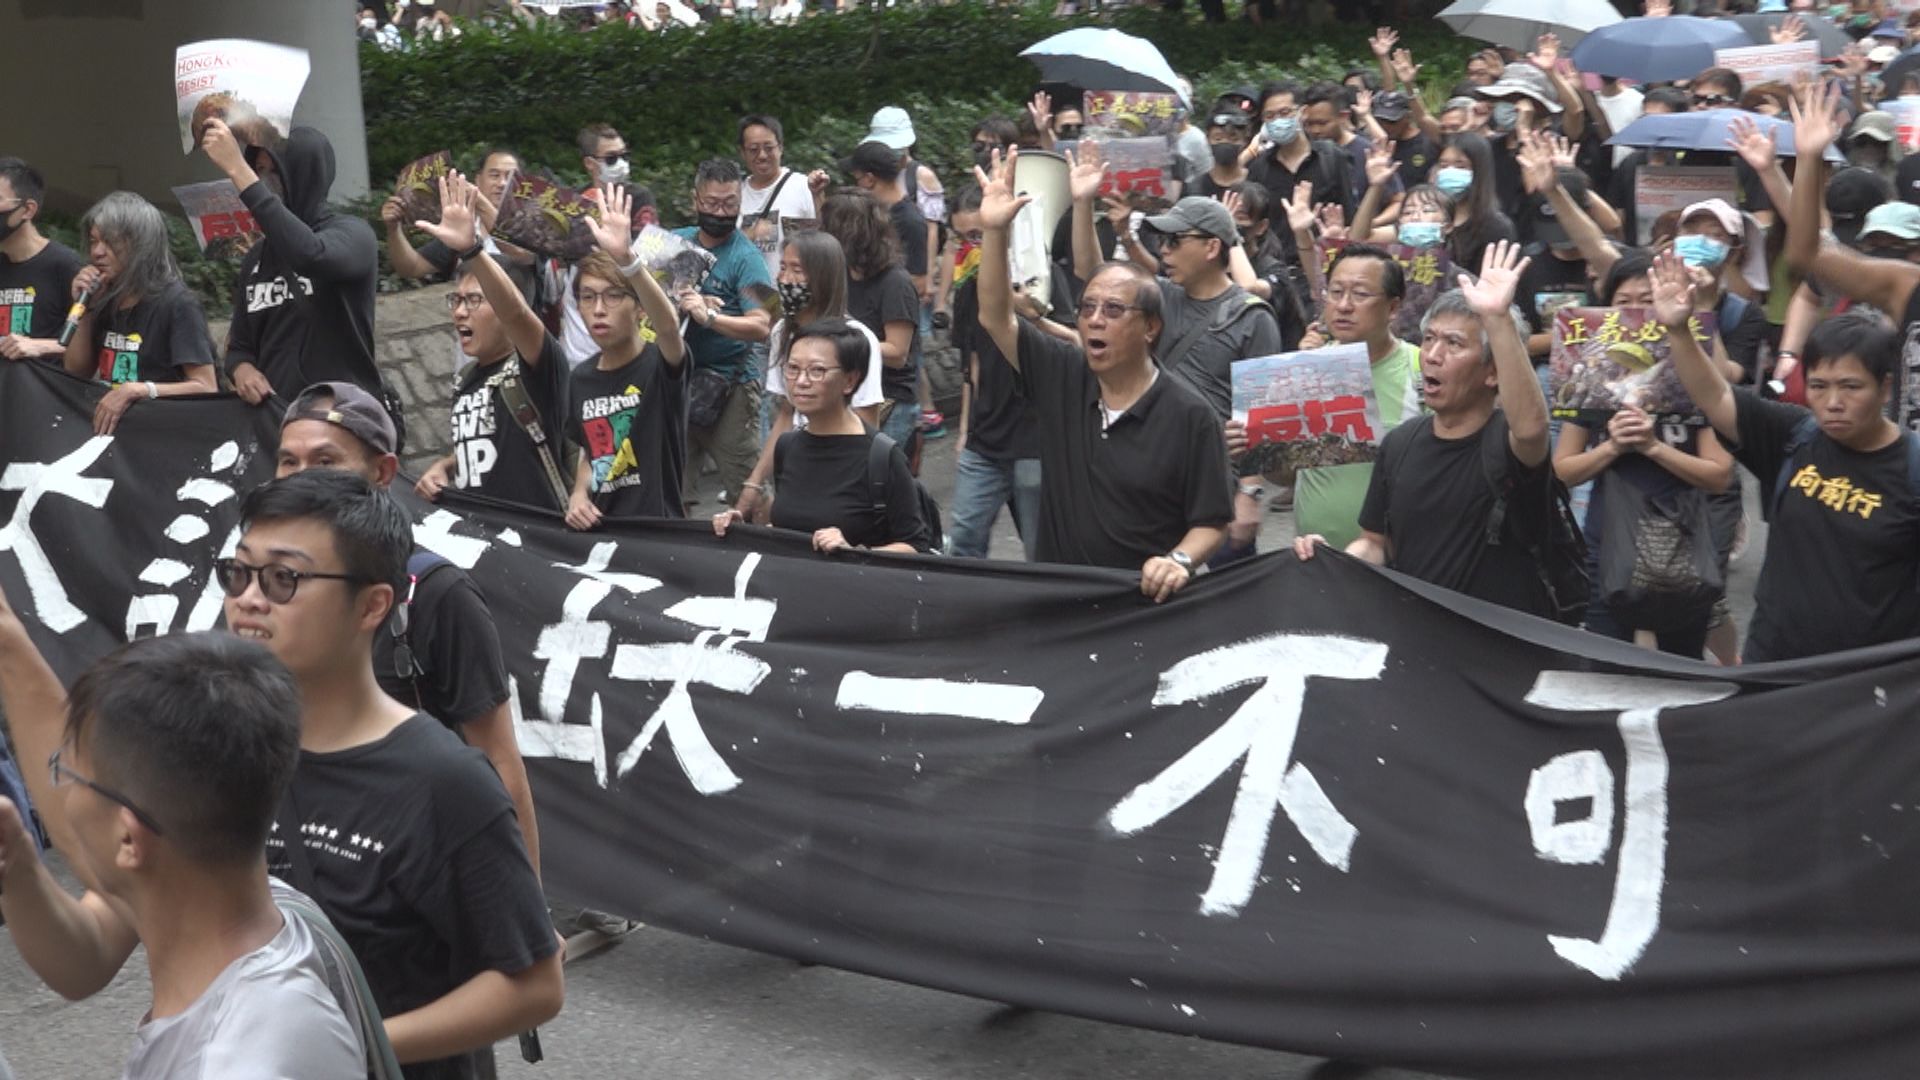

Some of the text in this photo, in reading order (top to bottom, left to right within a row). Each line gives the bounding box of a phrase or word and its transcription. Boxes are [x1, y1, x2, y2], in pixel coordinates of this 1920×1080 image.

[178, 76, 216, 96] RESIST
[1099, 168, 1165, 196] 抗
[1247, 395, 1375, 448] 反抗
[1790, 464, 1882, 519] 向前行
